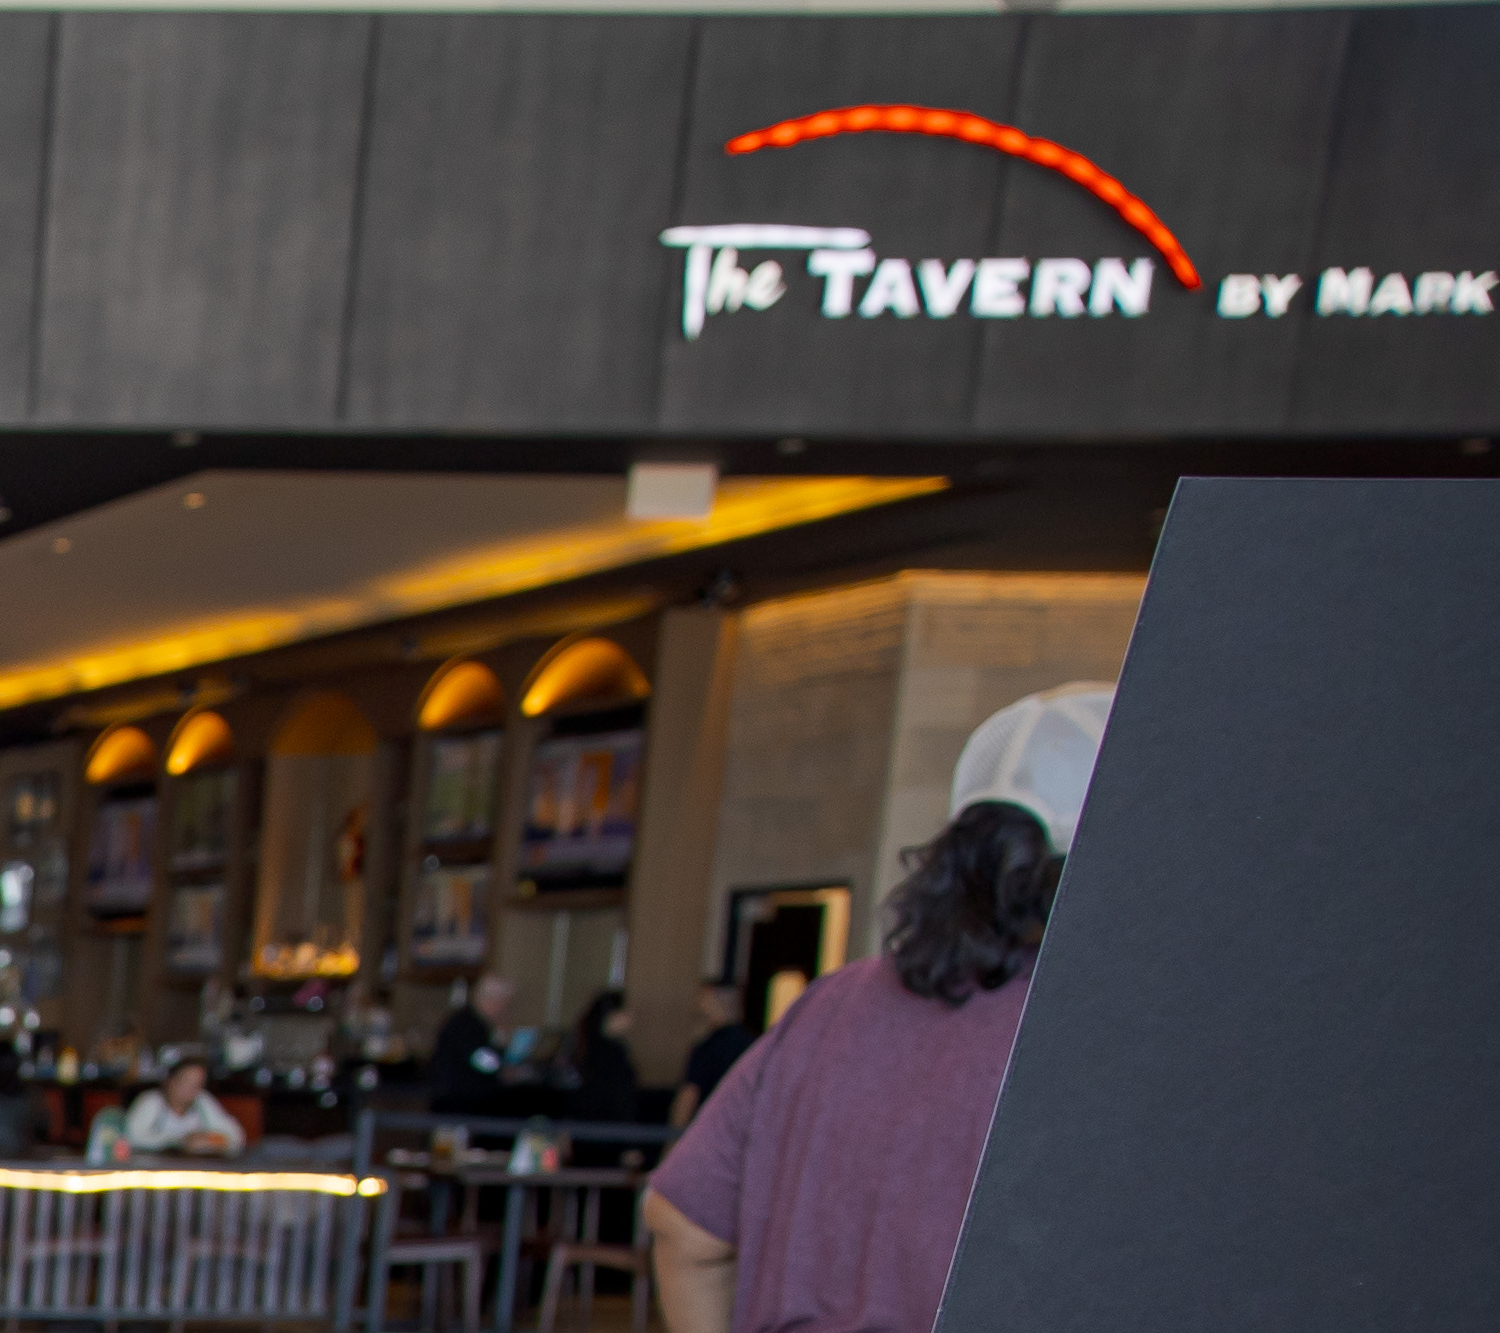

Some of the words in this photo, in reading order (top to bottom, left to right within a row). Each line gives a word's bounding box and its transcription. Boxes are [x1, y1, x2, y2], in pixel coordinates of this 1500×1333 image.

[660, 223, 845, 341] The
[807, 248, 1156, 319] TAVERN
[1216, 273, 1304, 317] BY
[1315, 266, 1498, 317] MARK
